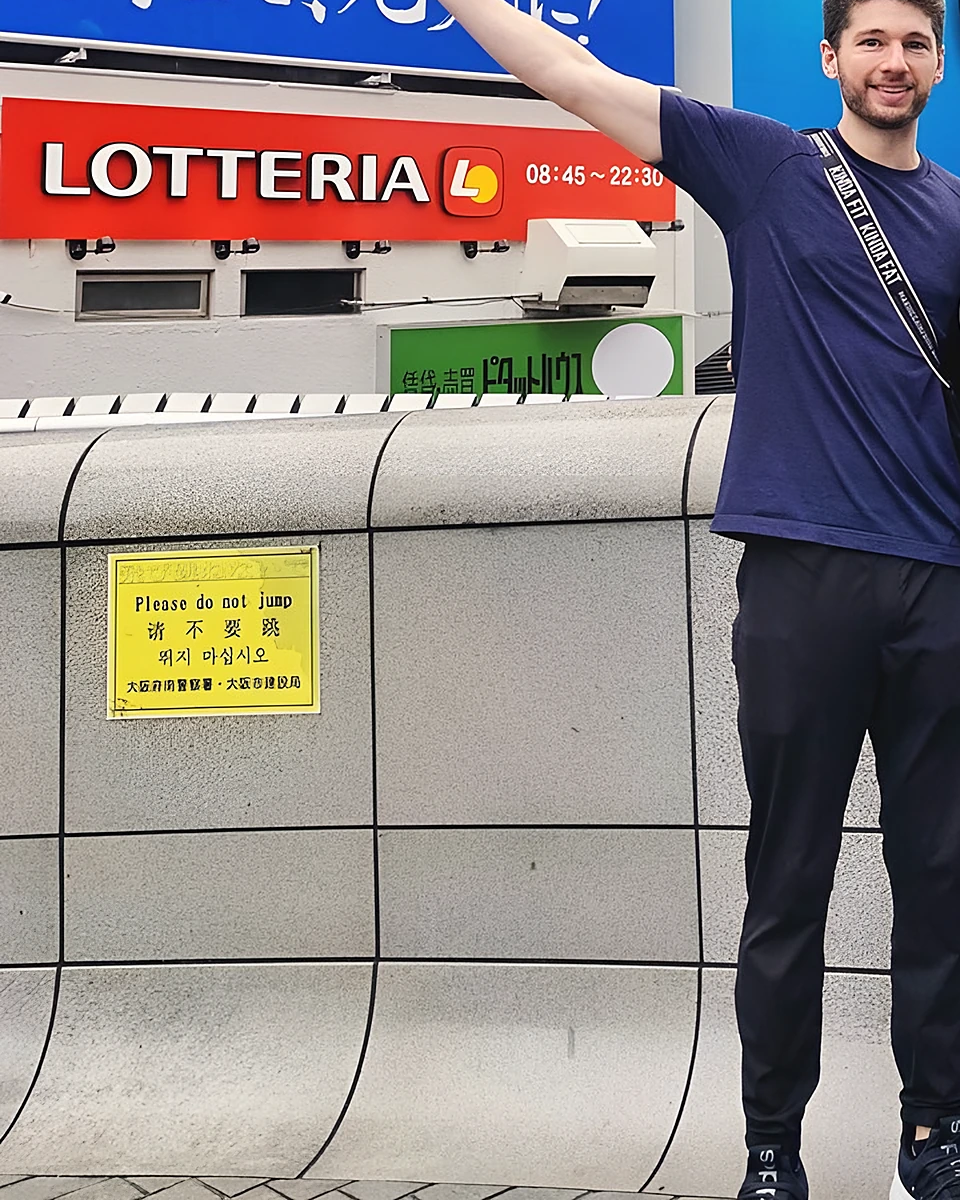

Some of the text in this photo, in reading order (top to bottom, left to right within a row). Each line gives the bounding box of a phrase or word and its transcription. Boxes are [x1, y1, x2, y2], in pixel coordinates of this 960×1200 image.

[42, 142, 431, 203] LOTTERIA
[828, 164, 904, 287] KINDA FIT KINDA FAT
[135, 591, 293, 612] Please do not jump
[202, 646, 270, 666] 마십시오
